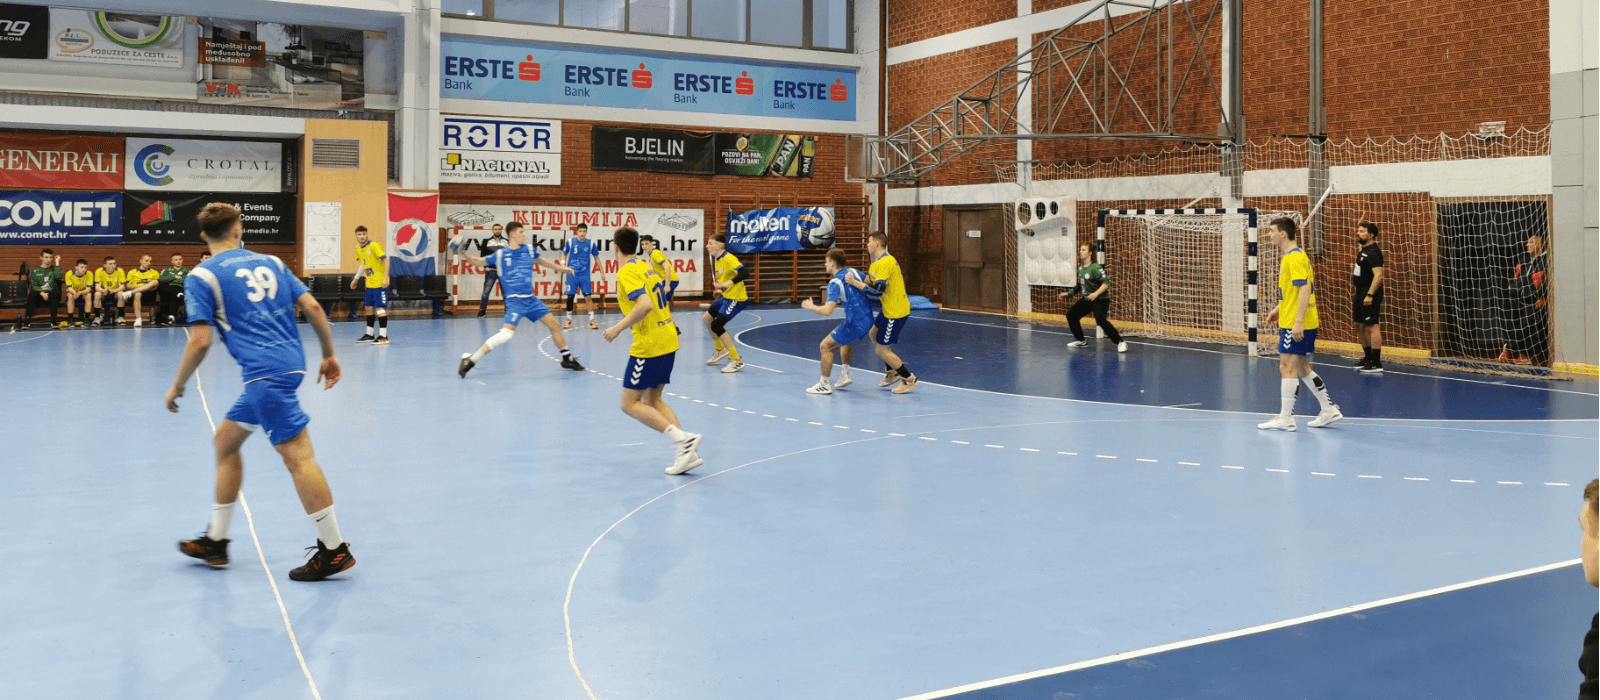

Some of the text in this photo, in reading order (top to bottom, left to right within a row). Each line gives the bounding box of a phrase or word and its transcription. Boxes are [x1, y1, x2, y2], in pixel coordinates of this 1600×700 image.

[205, 41, 243, 50] Namještaj
[444, 56, 514, 80] ERSTE
[564, 64, 628, 87] ERSTE
[444, 78, 473, 91] Bank
[674, 72, 732, 94] ERSTE
[773, 79, 827, 100] ERSTE
[564, 86, 590, 98] Bank
[674, 93, 698, 104] Bank
[773, 99, 796, 110] Bank
[444, 118, 551, 149] ROTOR
[625, 137, 684, 156] BJELIN
[776, 140, 795, 167] PAN
[187, 158, 274, 171] CROTAL
[460, 159, 550, 173] NACIONAL
[803, 157, 811, 173] PAN
[244, 203, 273, 211] Events
[239, 213, 280, 223] Company
[512, 210, 639, 227] KUDUMIJA
[730, 216, 790, 233] molten
[728, 235, 741, 243] For
[741, 235, 755, 243] the
[234, 266, 278, 303] 39
